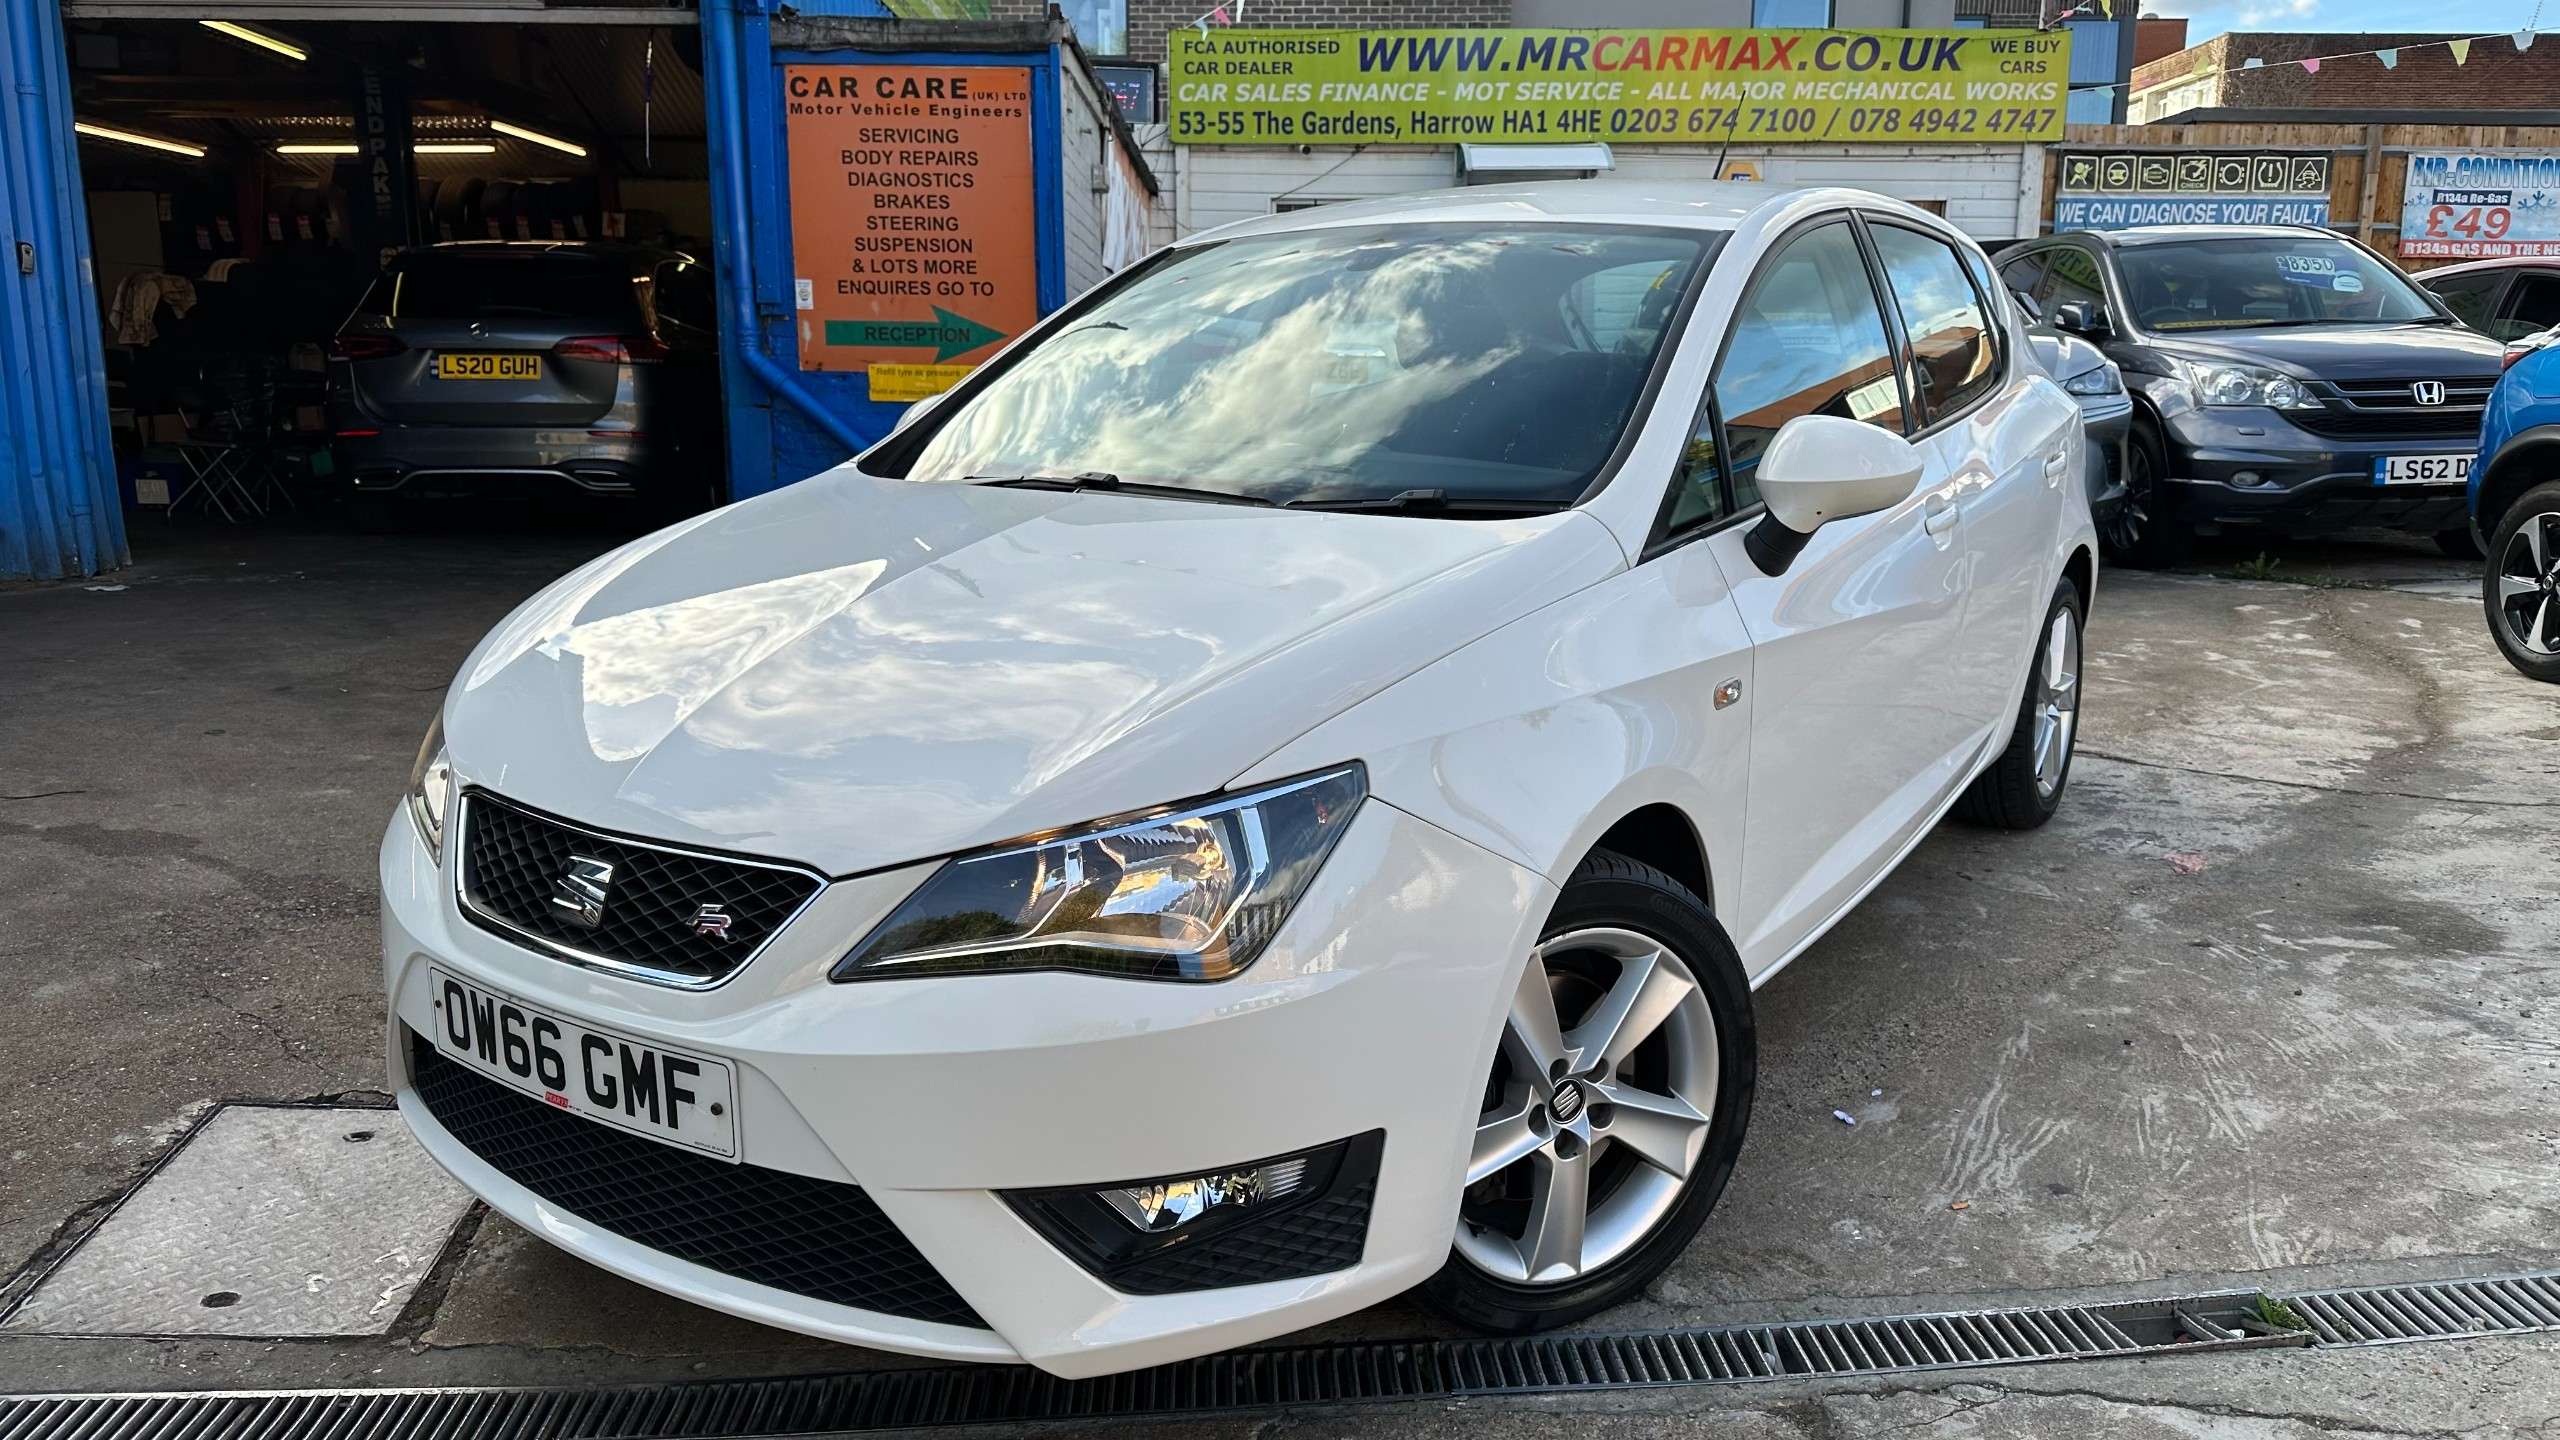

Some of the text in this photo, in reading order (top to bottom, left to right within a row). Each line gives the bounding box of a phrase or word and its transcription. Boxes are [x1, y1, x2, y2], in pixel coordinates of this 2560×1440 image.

[1184, 40, 1341, 55] FCA AUTHORISED
[1358, 35, 1970, 73] WWW.MRCARMAX.CO.UK
[1990, 40, 2061, 54] WE BUY
[1184, 61, 1294, 75] CAR DEALER
[2000, 61, 2047, 74] CARS
[789, 77, 1027, 101] CAR CARE (UK) LTD
[1178, 83, 1229, 101] CAR
[1233, 83, 1312, 101] SALES
[1319, 83, 1431, 101] FINANCE
[1452, 82, 1510, 101] MOT
[1515, 82, 1623, 101] SERVICE
[1647, 82, 1691, 101] ALL
[1701, 82, 1786, 101] MAJOR
[1793, 82, 1957, 101] MECHANICAL
[1965, 82, 2059, 101] WORKS
[790, 103, 1022, 119] Motor Vehicle Engineers
[1178, 111, 1245, 135] 53-55
[1252, 111, 1294, 135] The
[1301, 110, 1401, 140] Gardens,
[1410, 110, 1494, 135] Harrow
[1503, 110, 1547, 134] HA1
[1556, 109, 1601, 133] 4HE
[1610, 108, 1677, 133] 0203
[1687, 108, 1738, 133] 674
[1749, 108, 1816, 133] 7100
[1849, 108, 1900, 133] 078
[1908, 108, 1977, 133] 4942
[1985, 108, 2057, 133] 4747
[859, 128, 959, 144] SERVICING
[841, 150, 979, 166] BODY REPAIRS
[848, 172, 974, 188] DIAGNOSTICS
[873, 194, 950, 209] BRAKES
[2436, 193, 2509, 204] R134a Re-Gas
[2059, 203, 2323, 225] WE CAN DIAGNOSE YOUR FAULT
[2424, 205, 2512, 239] £49
[866, 216, 959, 231] STEERING
[854, 237, 973, 253] SUSPENSION
[2404, 242, 2449, 254] R134a
[2451, 242, 2480, 255] GAS
[2482, 243, 2512, 255] AND
[2515, 243, 2541, 256] THE
[852, 259, 978, 274] & LOTS MORE
[837, 280, 995, 296] ENQUIRES GO TO
[864, 327, 971, 343] RECEPTION
[443, 357, 538, 375] LS20 GUH
[2390, 458, 2475, 480] LS62 D
[443, 979, 700, 1130] OW66 GMF
